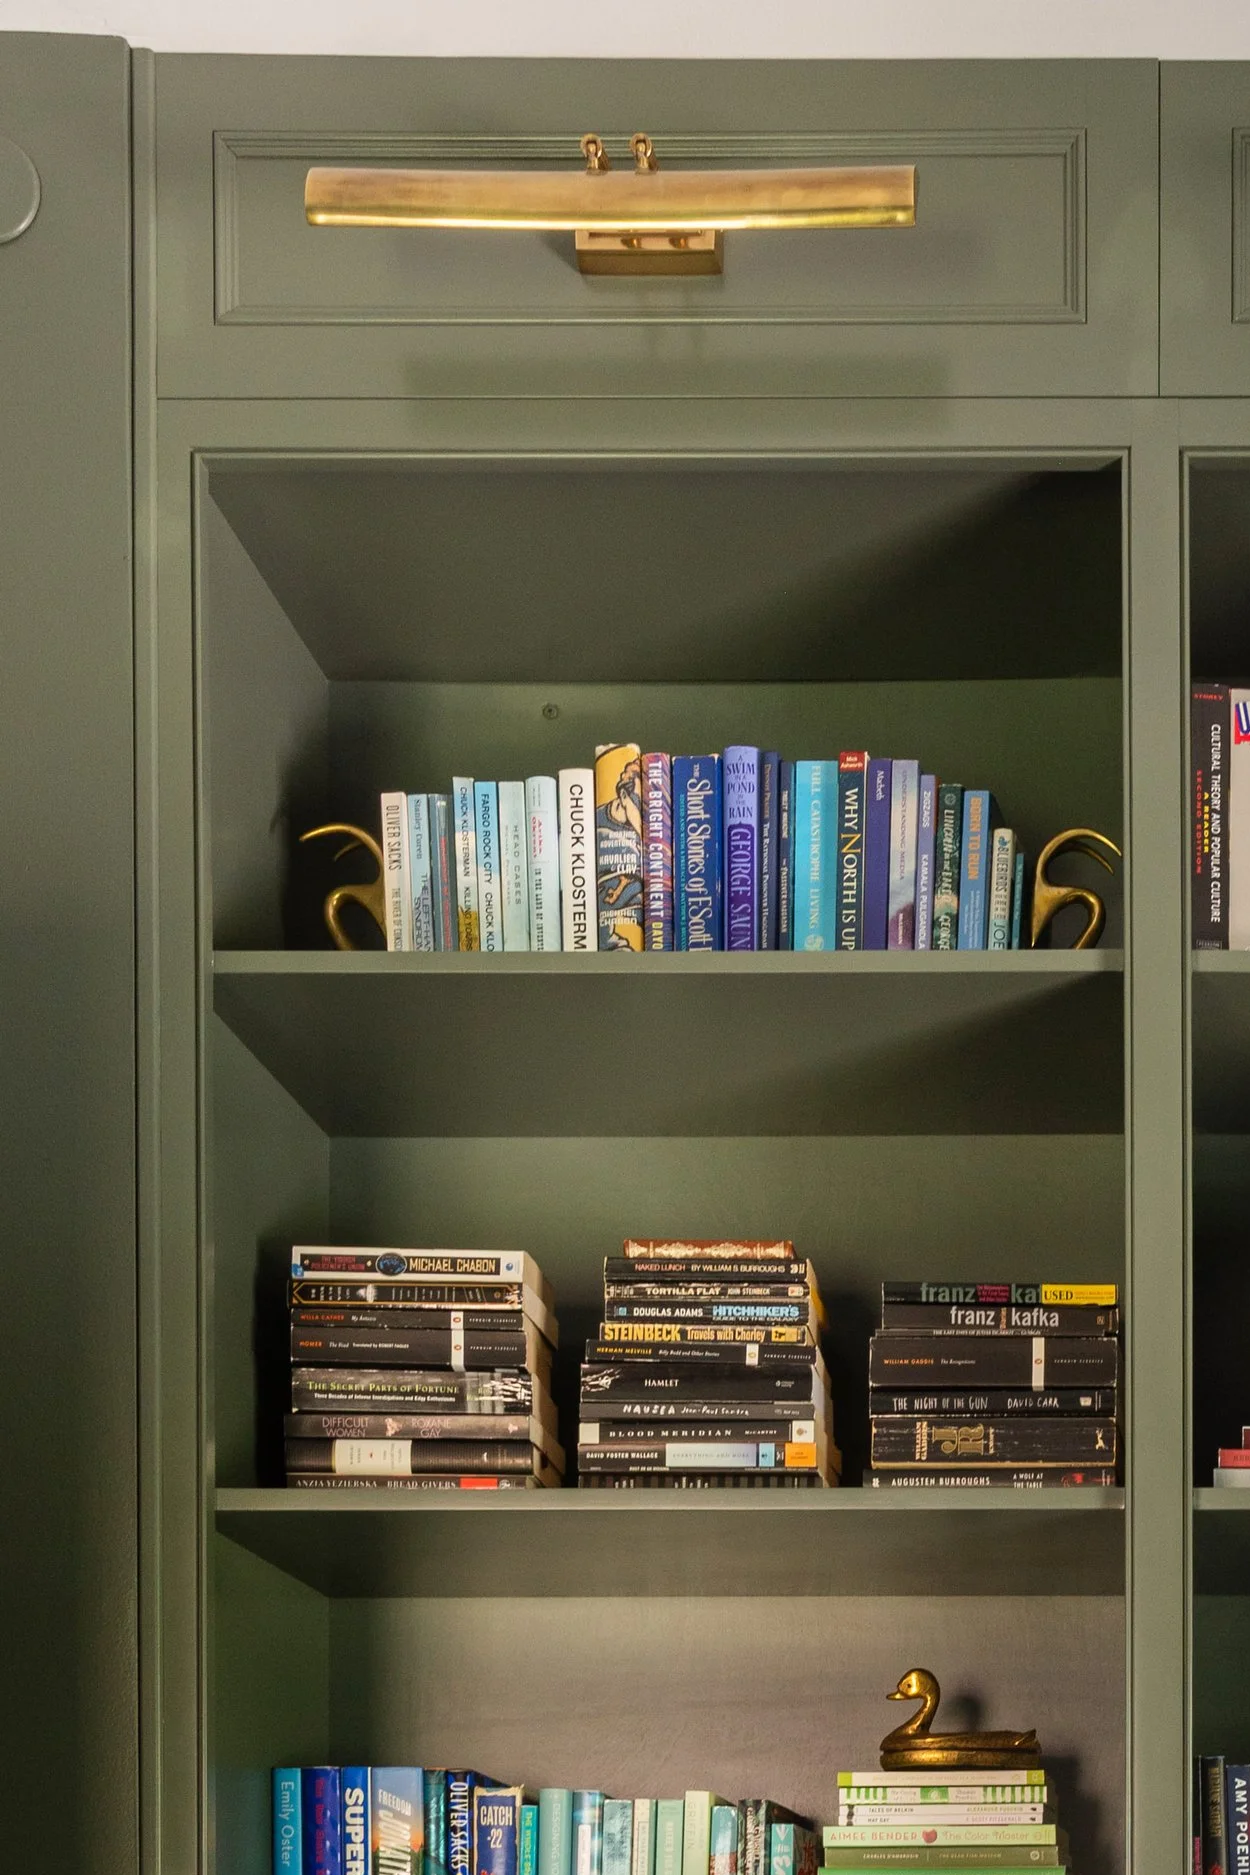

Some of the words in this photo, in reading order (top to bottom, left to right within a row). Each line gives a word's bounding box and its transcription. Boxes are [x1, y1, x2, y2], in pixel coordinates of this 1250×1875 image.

[726, 763, 756, 776] SWIM
[727, 780, 756, 795] POND
[460, 786, 468, 817] CHUCK
[481, 793, 490, 827] FARGO
[728, 805, 754, 819] RAIN
[844, 787, 859, 830] WHY
[922, 791, 931, 828] ZIGZAGS
[386, 805, 401, 838] OLIVER
[461, 819, 470, 877] KLOSTERMAN
[483, 830, 491, 858] ROCK
[387, 842, 402, 871] SACKS
[841, 833, 862, 903] NORTH
[995, 845, 1009, 892] BLUEBIRDS
[484, 862, 493, 884] CITY
[920, 854, 929, 891] KAMALA
[485, 892, 493, 928] CHUCK
[842, 910, 856, 922] IS
[919, 895, 928, 949] PULIGANDLA
[842, 927, 856, 951] UP
[409, 1257, 454, 1272] MICHAEL
[456, 1258, 496, 1273] CHABON
[646, 1287, 695, 1296] TORTILLA
[697, 1287, 721, 1295] FLAT
[1044, 1290, 1073, 1301] USED
[633, 1307, 672, 1317] DOUGLAS
[674, 1307, 703, 1317] ADAMS
[950, 1306, 995, 1326] franz
[1011, 1308, 1060, 1327] kafka
[604, 1324, 681, 1342] STEINBECK
[644, 1378, 680, 1388] HAMLET
[322, 1417, 369, 1428] DIFFICULT
[326, 1427, 367, 1438] WOMEN
[412, 1418, 451, 1428] ROXANE
[609, 1430, 655, 1438] BLOOD
[661, 1429, 732, 1437] MERIDIAN
[387, 1481, 418, 1489] BREAD
[420, 1481, 456, 1489] GIVERS
[279, 1781, 295, 1821] Emily
[450, 1782, 469, 1828] OLIVER
[1234, 1778, 1248, 1813] AMY
[480, 1805, 514, 1826] CATCH
[281, 1825, 295, 1867] Oster
[451, 1831, 469, 1870] SACKS
